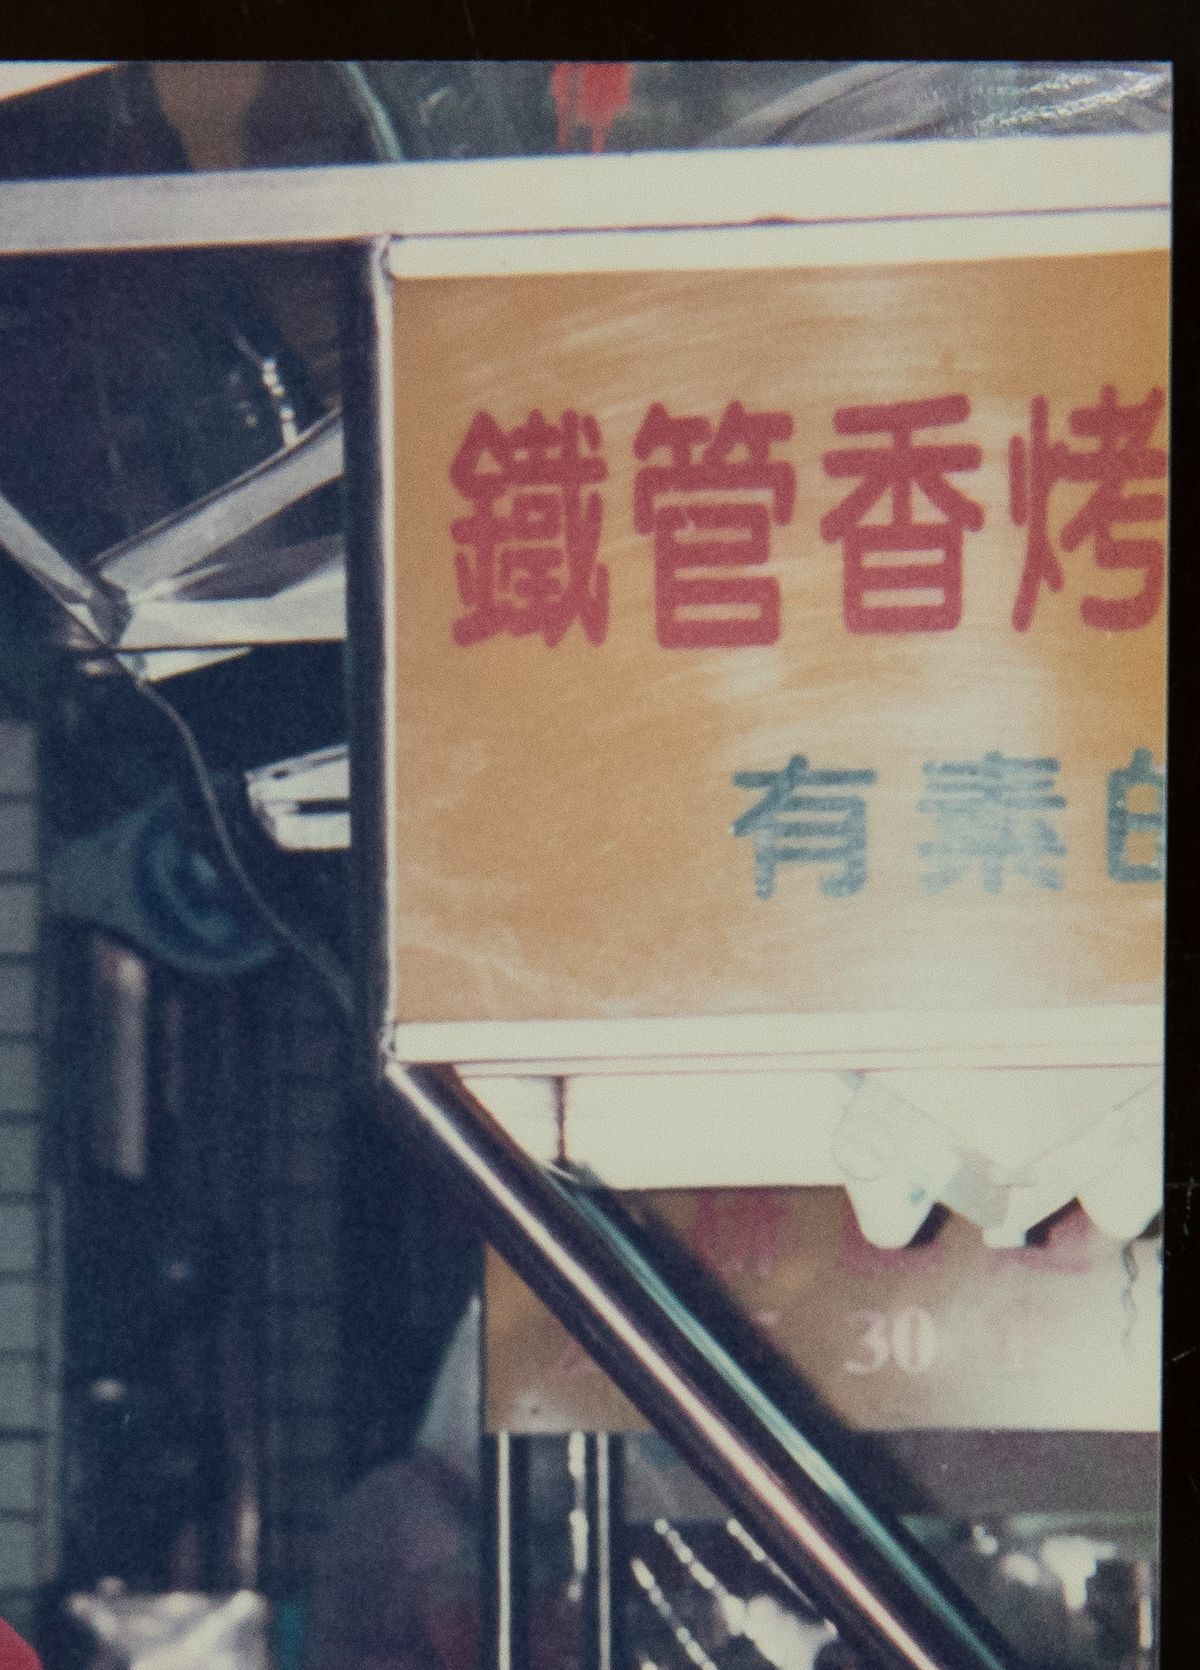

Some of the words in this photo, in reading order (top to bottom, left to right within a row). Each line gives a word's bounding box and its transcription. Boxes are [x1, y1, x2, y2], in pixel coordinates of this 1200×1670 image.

[450, 385, 1167, 649] 鐵管香烤
[843, 1305, 938, 1374] 30
